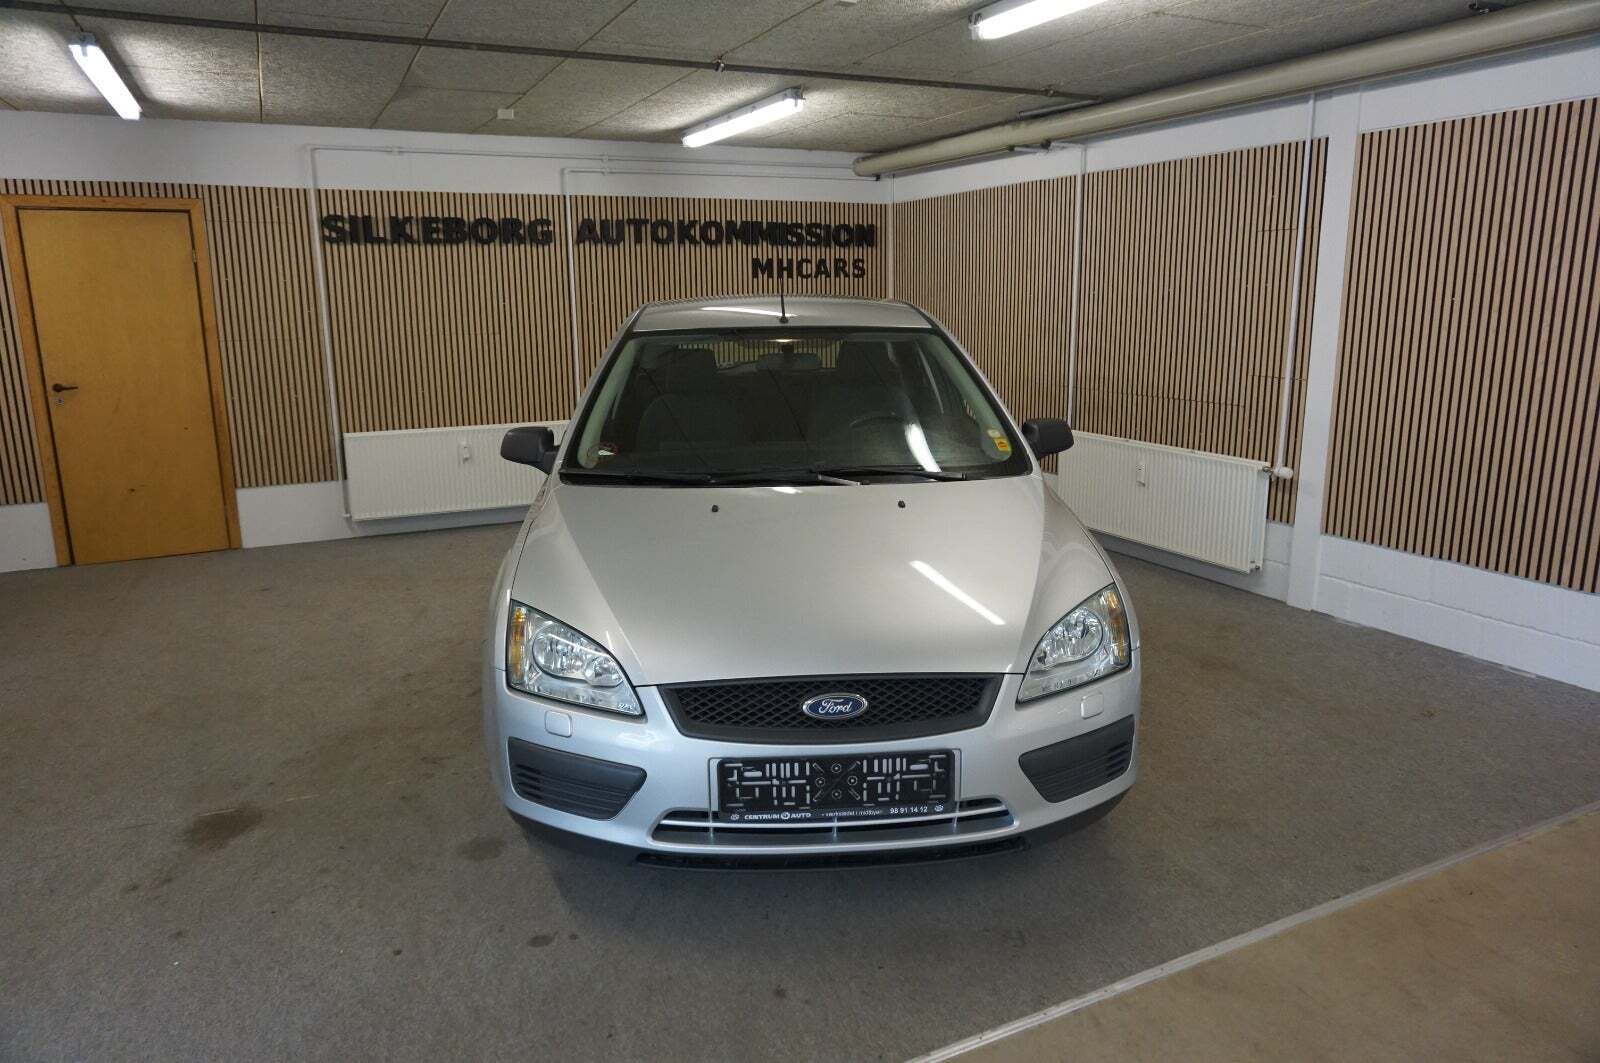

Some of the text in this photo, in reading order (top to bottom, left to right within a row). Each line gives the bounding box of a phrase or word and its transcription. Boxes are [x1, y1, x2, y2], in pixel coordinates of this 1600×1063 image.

[321, 214, 876, 247] SILKEBORG AUTOKOMMISSION
[751, 257, 866, 279] MHCARS
[818, 699, 853, 714] Ford
